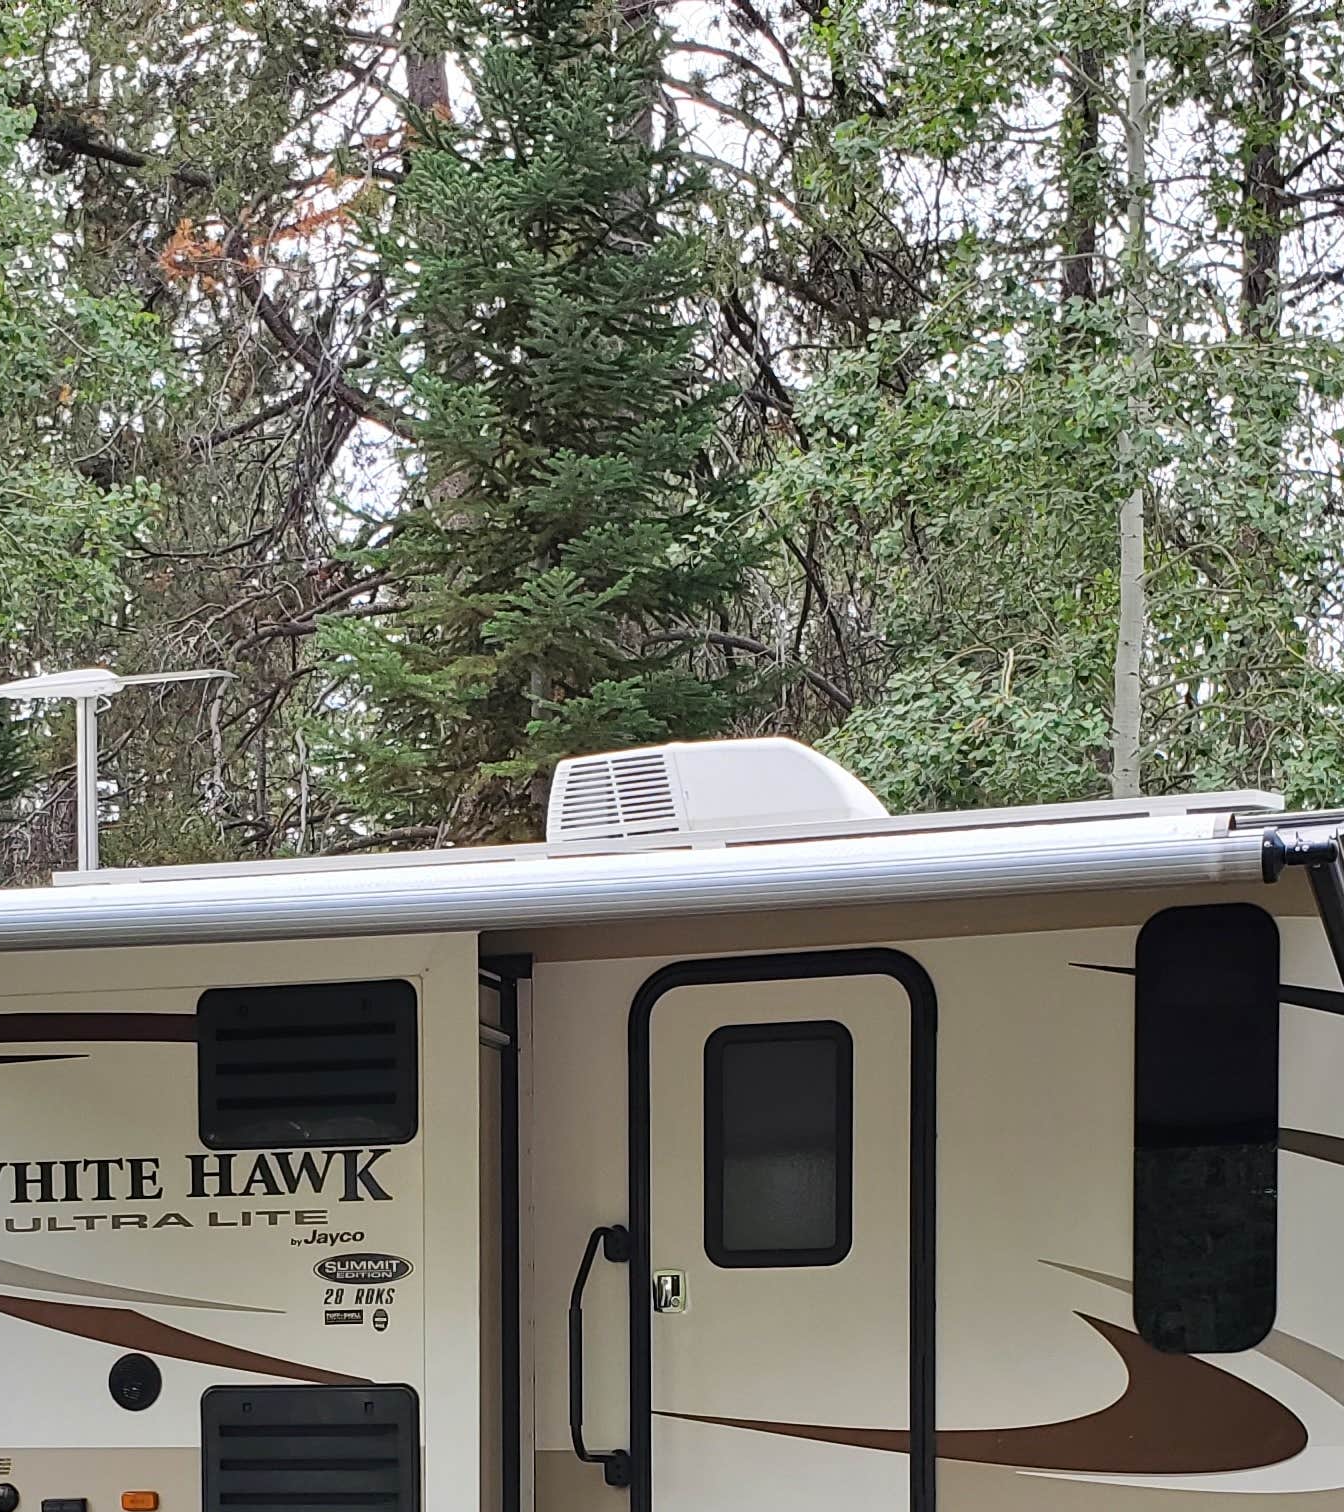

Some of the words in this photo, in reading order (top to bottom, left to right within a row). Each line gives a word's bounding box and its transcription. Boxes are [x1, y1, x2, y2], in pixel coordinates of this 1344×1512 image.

[185, 1148, 394, 1202] HAWK
[5, 1212, 194, 1233] ULTRA
[208, 1209, 329, 1227] LITE
[290, 1237, 303, 1247] by
[303, 1228, 365, 1247] Jayco
[324, 1259, 401, 1274] SUMMIT
[336, 1270, 393, 1279] EDITION
[323, 1287, 345, 1305] 28
